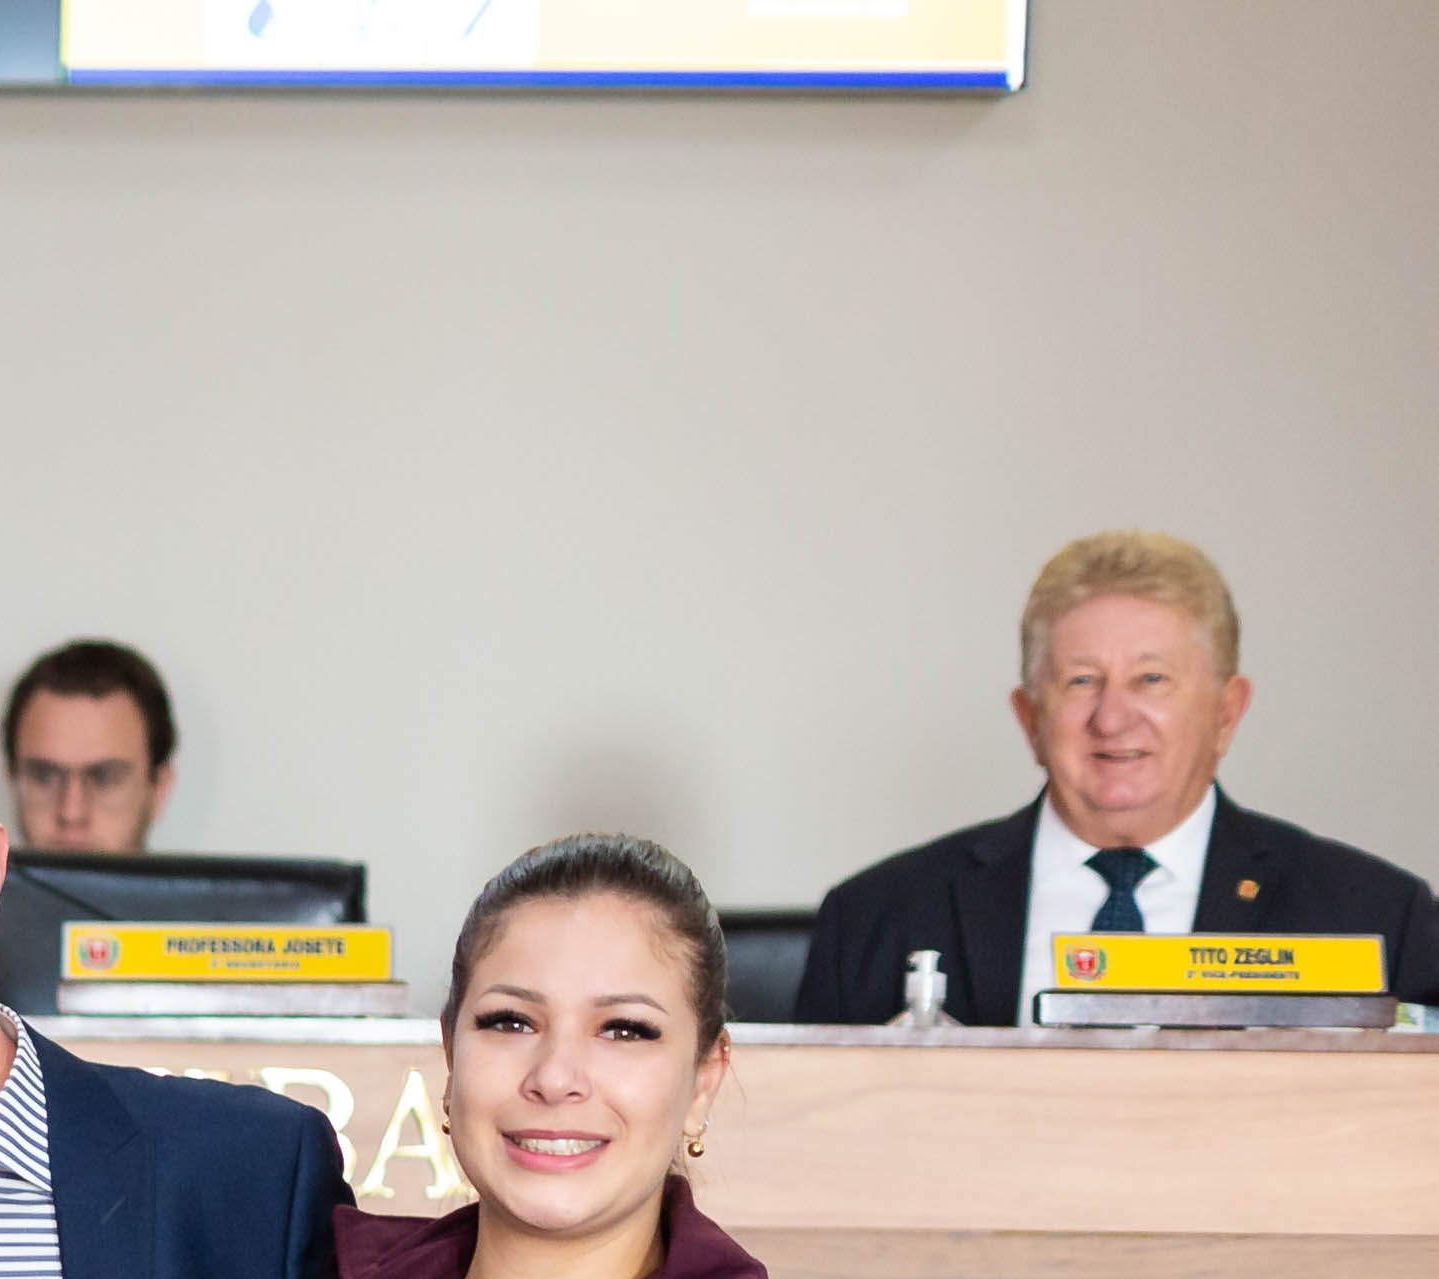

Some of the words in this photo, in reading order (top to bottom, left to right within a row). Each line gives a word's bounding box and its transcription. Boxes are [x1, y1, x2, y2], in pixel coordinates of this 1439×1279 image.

[166, 938, 275, 953] PROFESSORA
[283, 938, 345, 954] JOSETE
[1190, 947, 1228, 964] TITO
[1234, 947, 1294, 965] ZEGLIN
